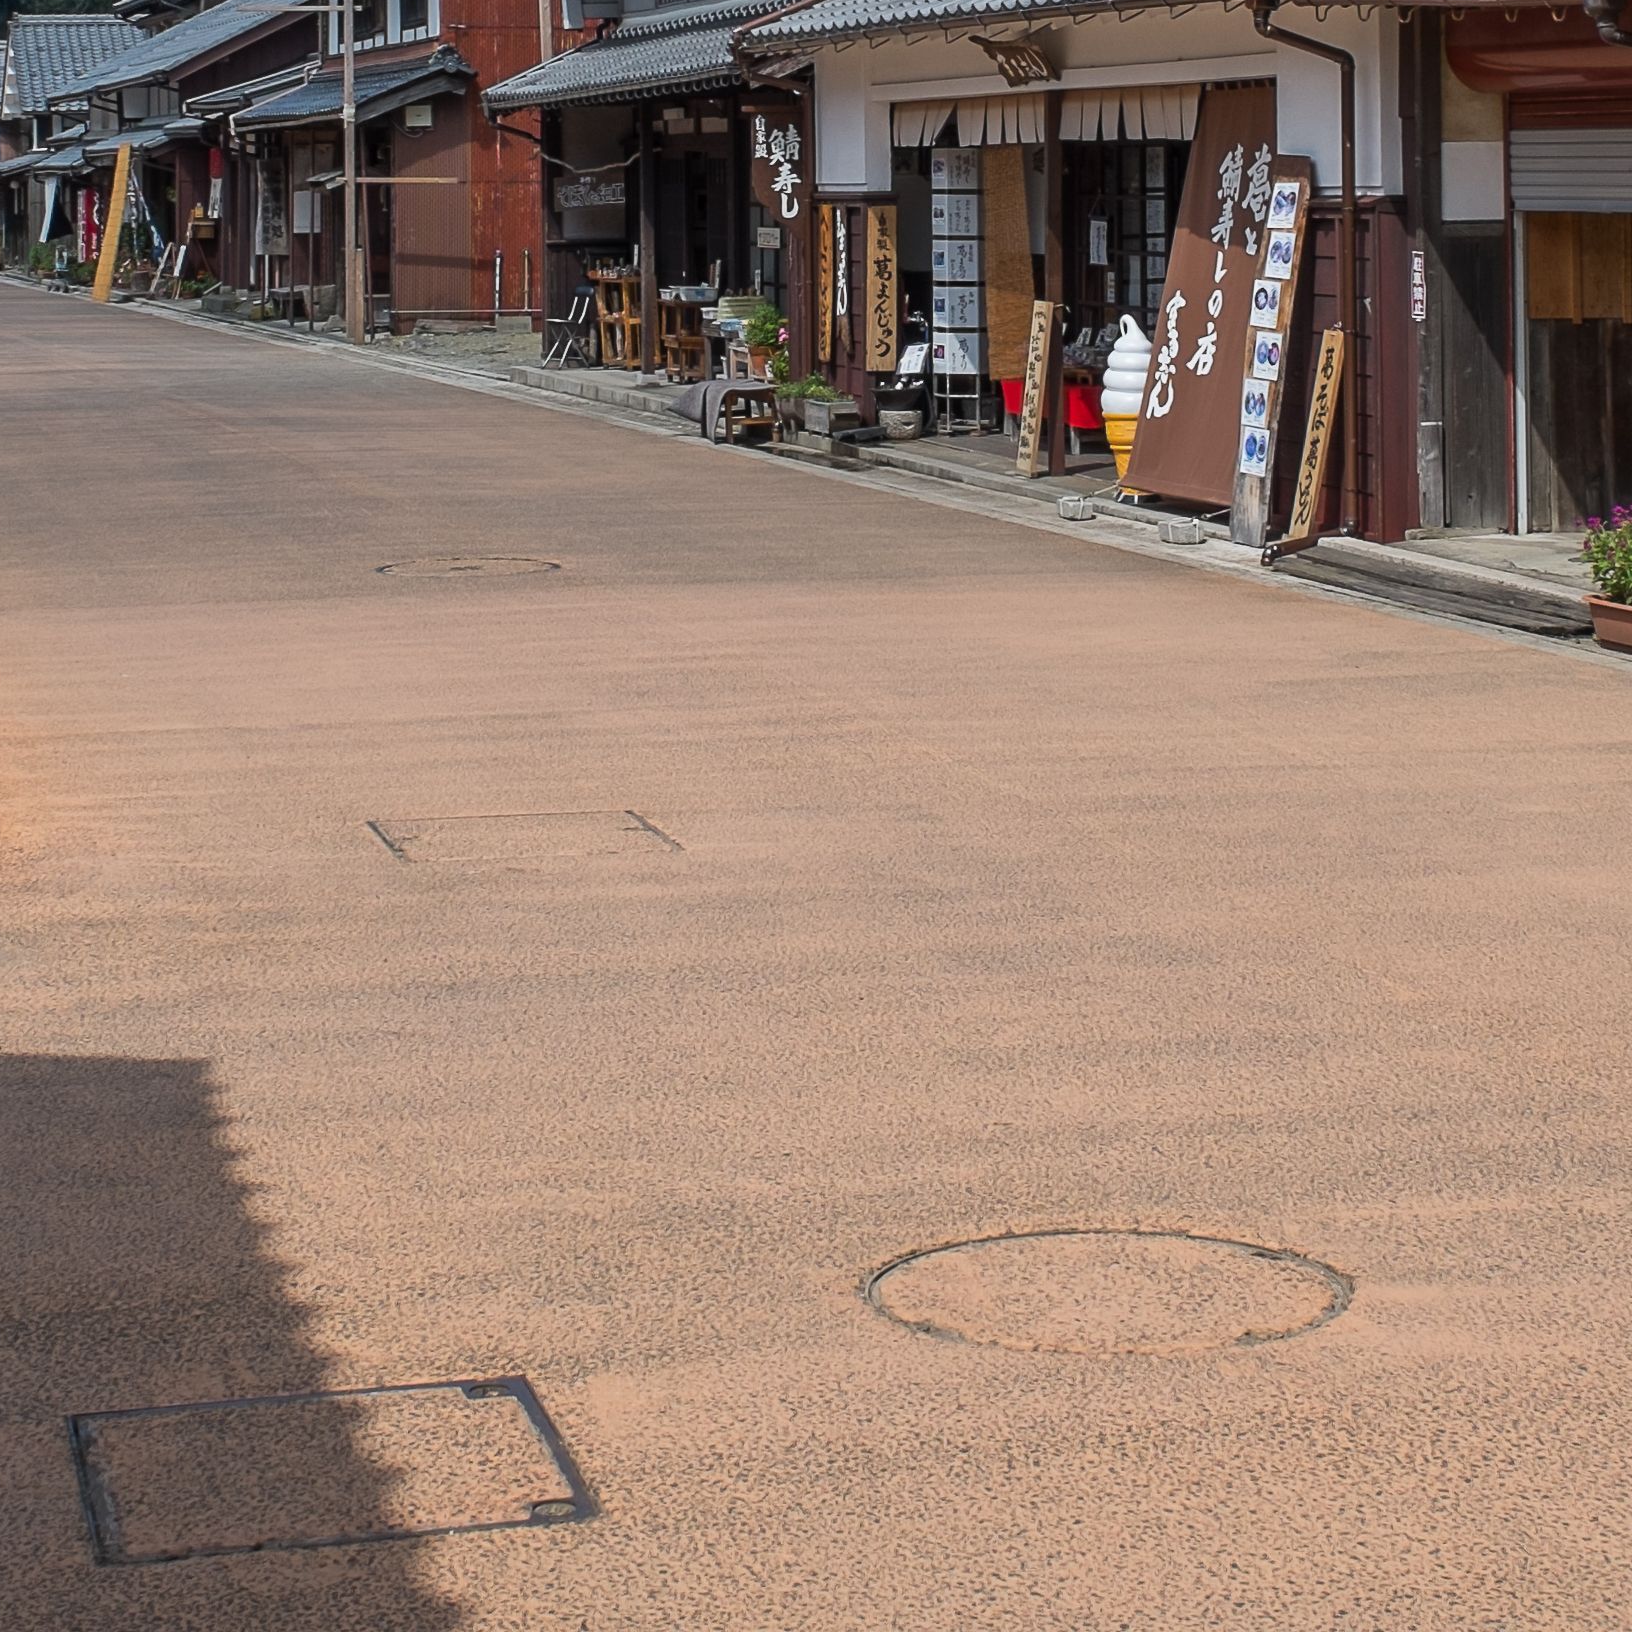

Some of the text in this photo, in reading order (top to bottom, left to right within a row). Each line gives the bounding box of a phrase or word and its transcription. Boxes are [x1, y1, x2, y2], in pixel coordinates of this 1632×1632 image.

[755, 114, 768, 159] 自家製
[768, 123, 802, 218] 鯖寿し
[1242, 143, 1271, 256] 葛と
[1186, 143, 1243, 376] 鯖寿しの店
